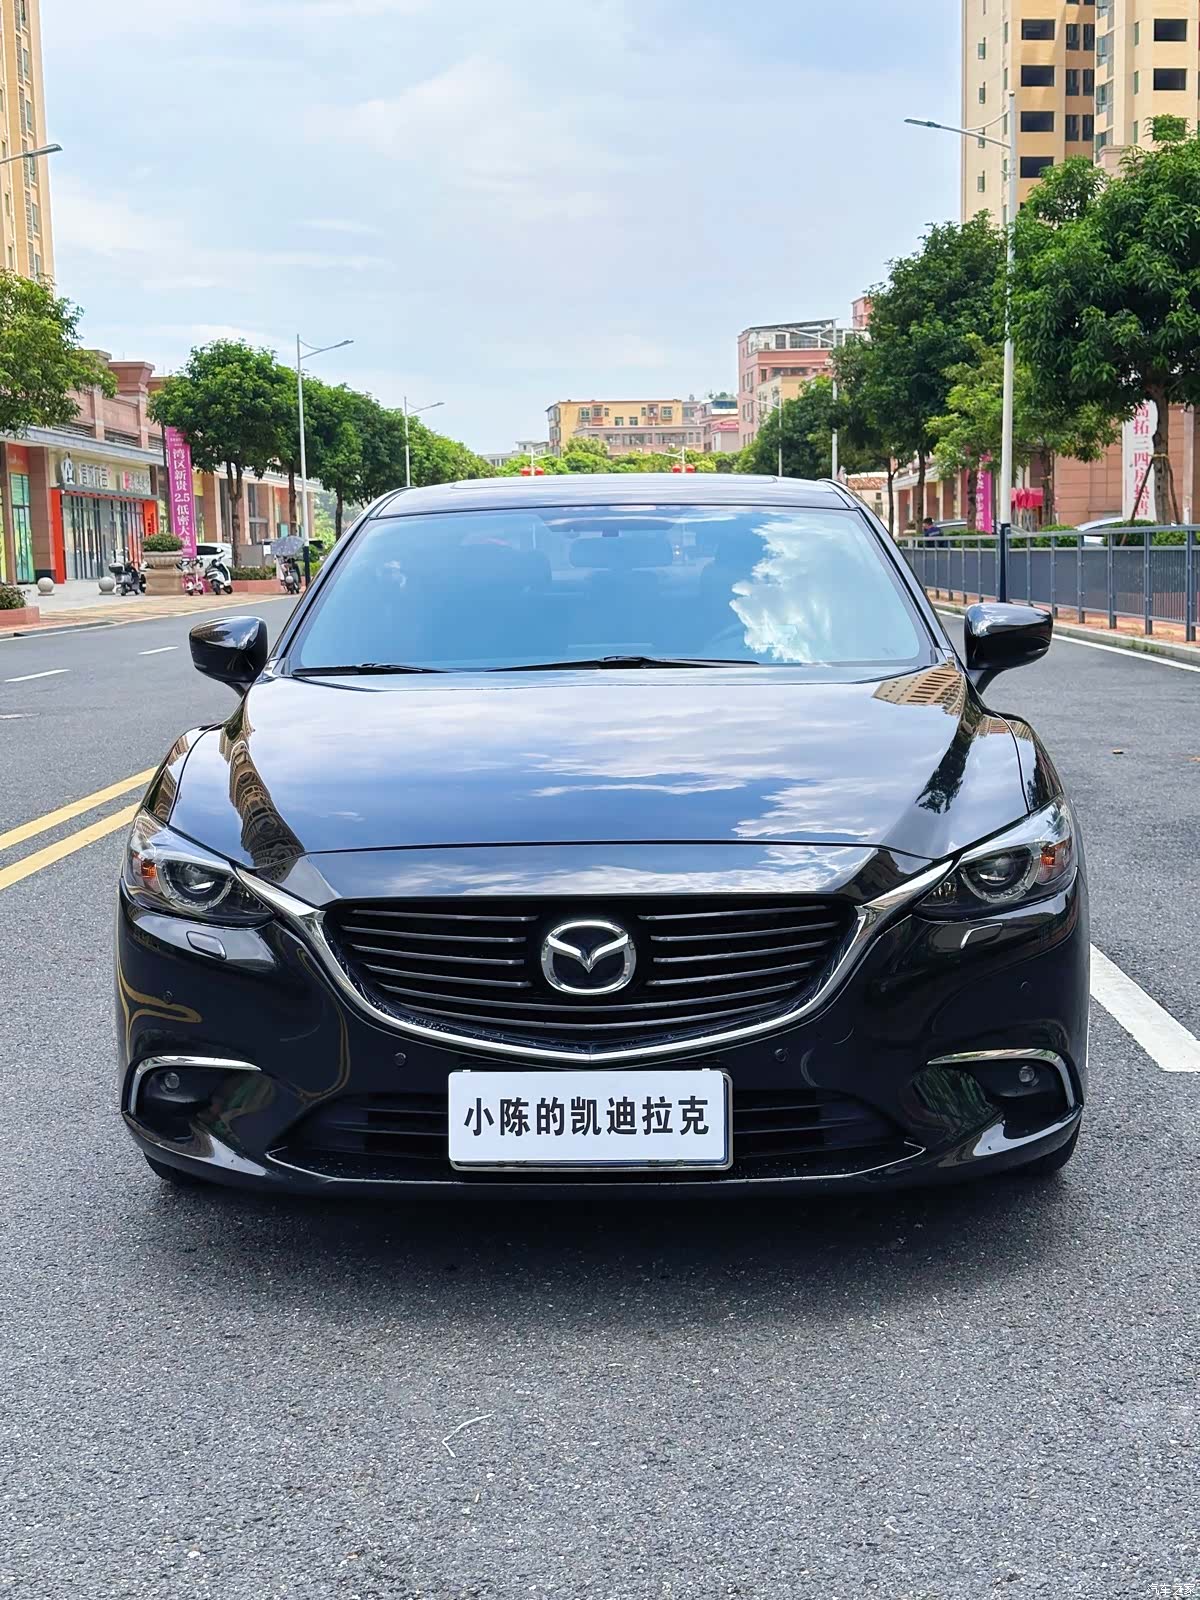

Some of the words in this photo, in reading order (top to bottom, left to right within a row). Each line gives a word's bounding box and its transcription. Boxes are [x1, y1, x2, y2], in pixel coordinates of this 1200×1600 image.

[463, 1096, 710, 1136] 小陈的凯迪拉克
